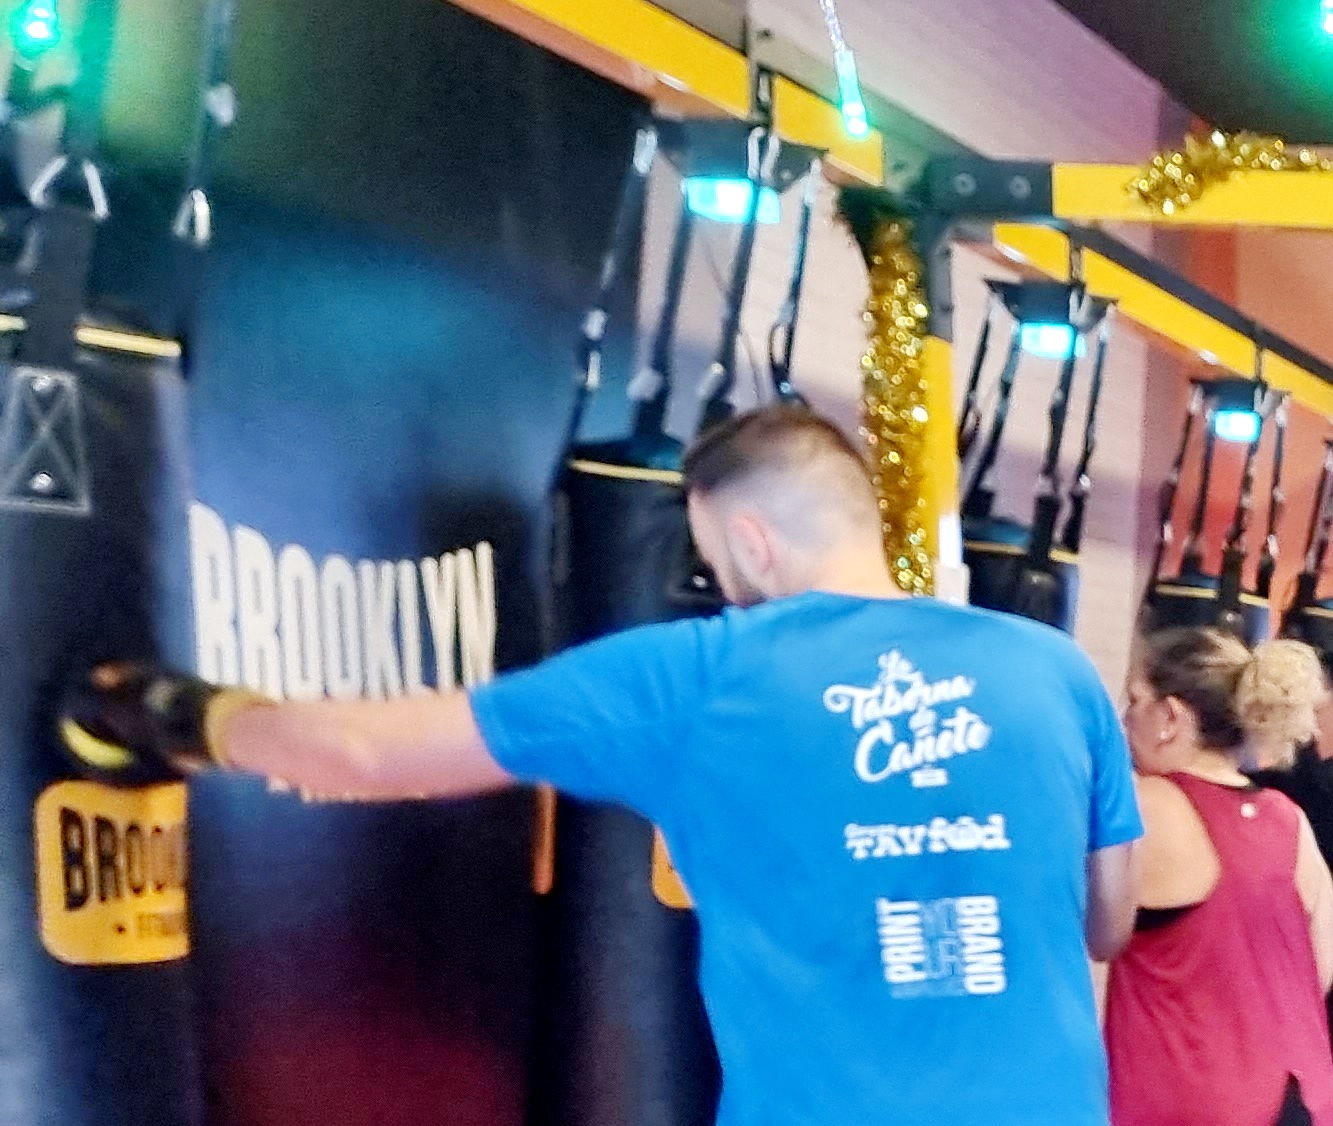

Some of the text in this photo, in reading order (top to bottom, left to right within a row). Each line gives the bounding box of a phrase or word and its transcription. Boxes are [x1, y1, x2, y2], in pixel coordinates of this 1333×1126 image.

[188, 503, 496, 703] BROOKLYN
[876, 897, 927, 983] PRINT
[955, 894, 1007, 994] BRAND
